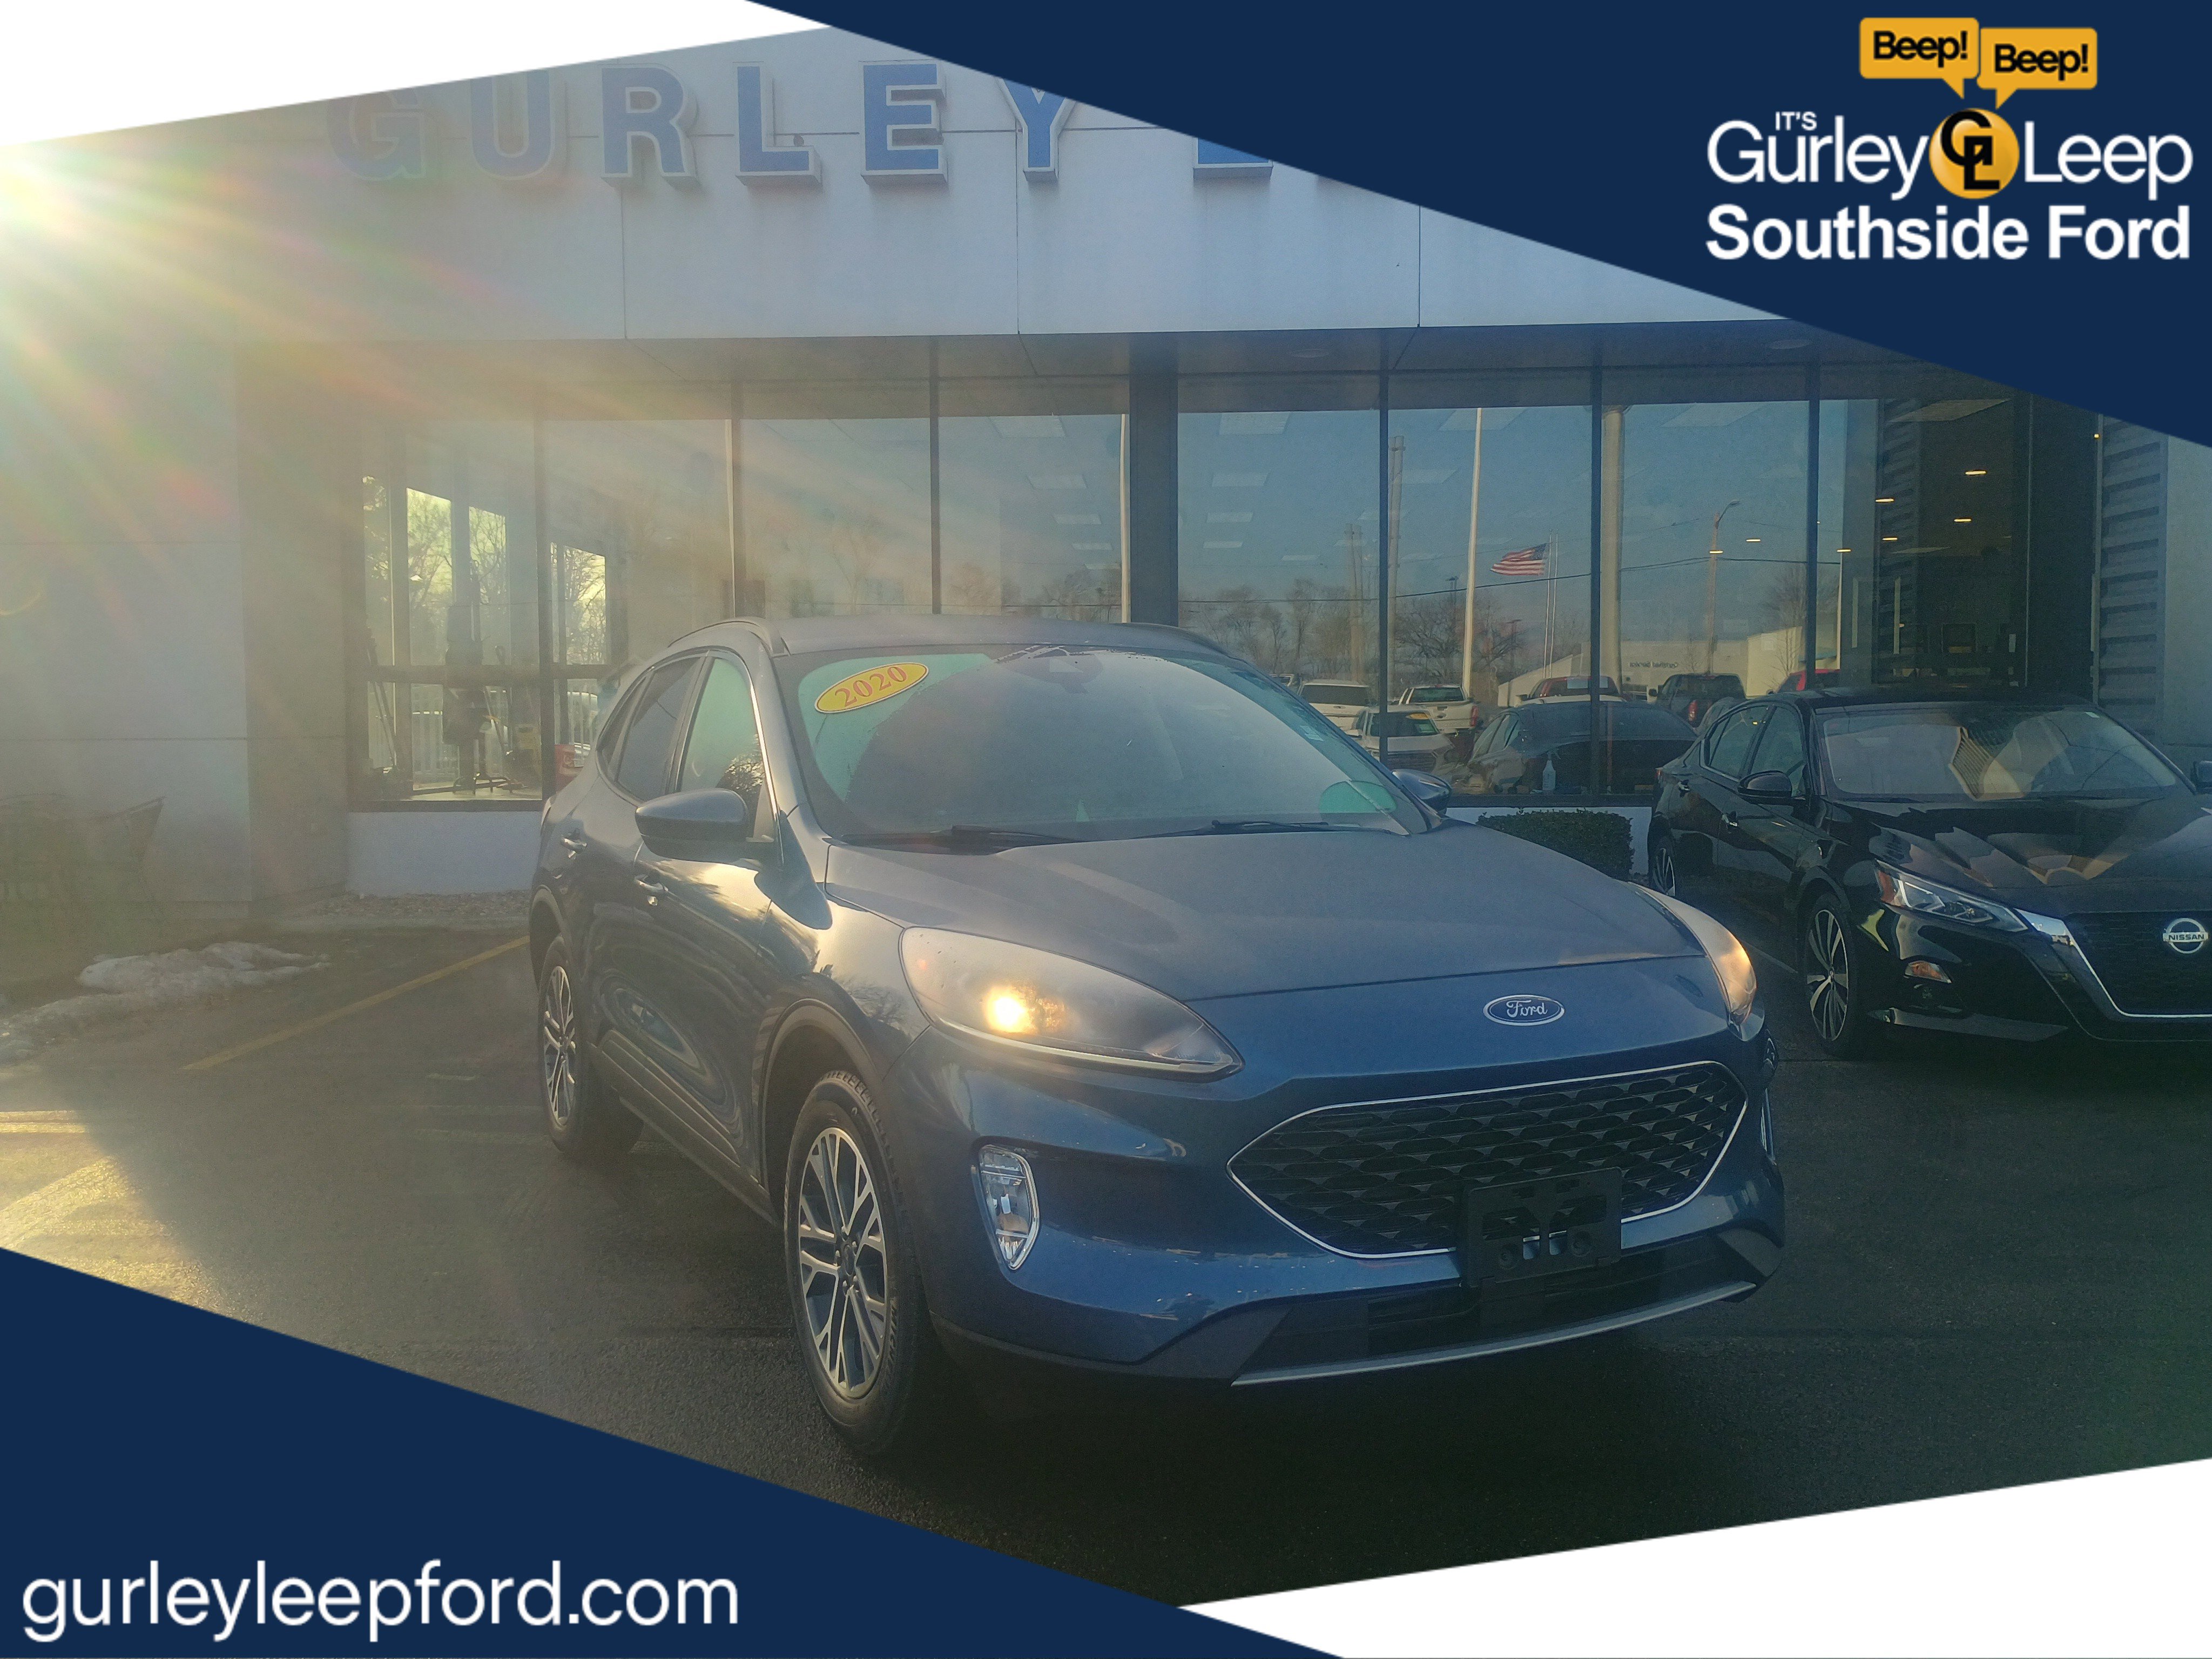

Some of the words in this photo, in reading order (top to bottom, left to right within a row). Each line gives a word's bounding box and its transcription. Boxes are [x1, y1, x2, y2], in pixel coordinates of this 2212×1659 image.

[326, 61, 1077, 184] GURLEY
[834, 666, 907, 707] 2020
[1506, 1000, 1548, 1018] Ford
